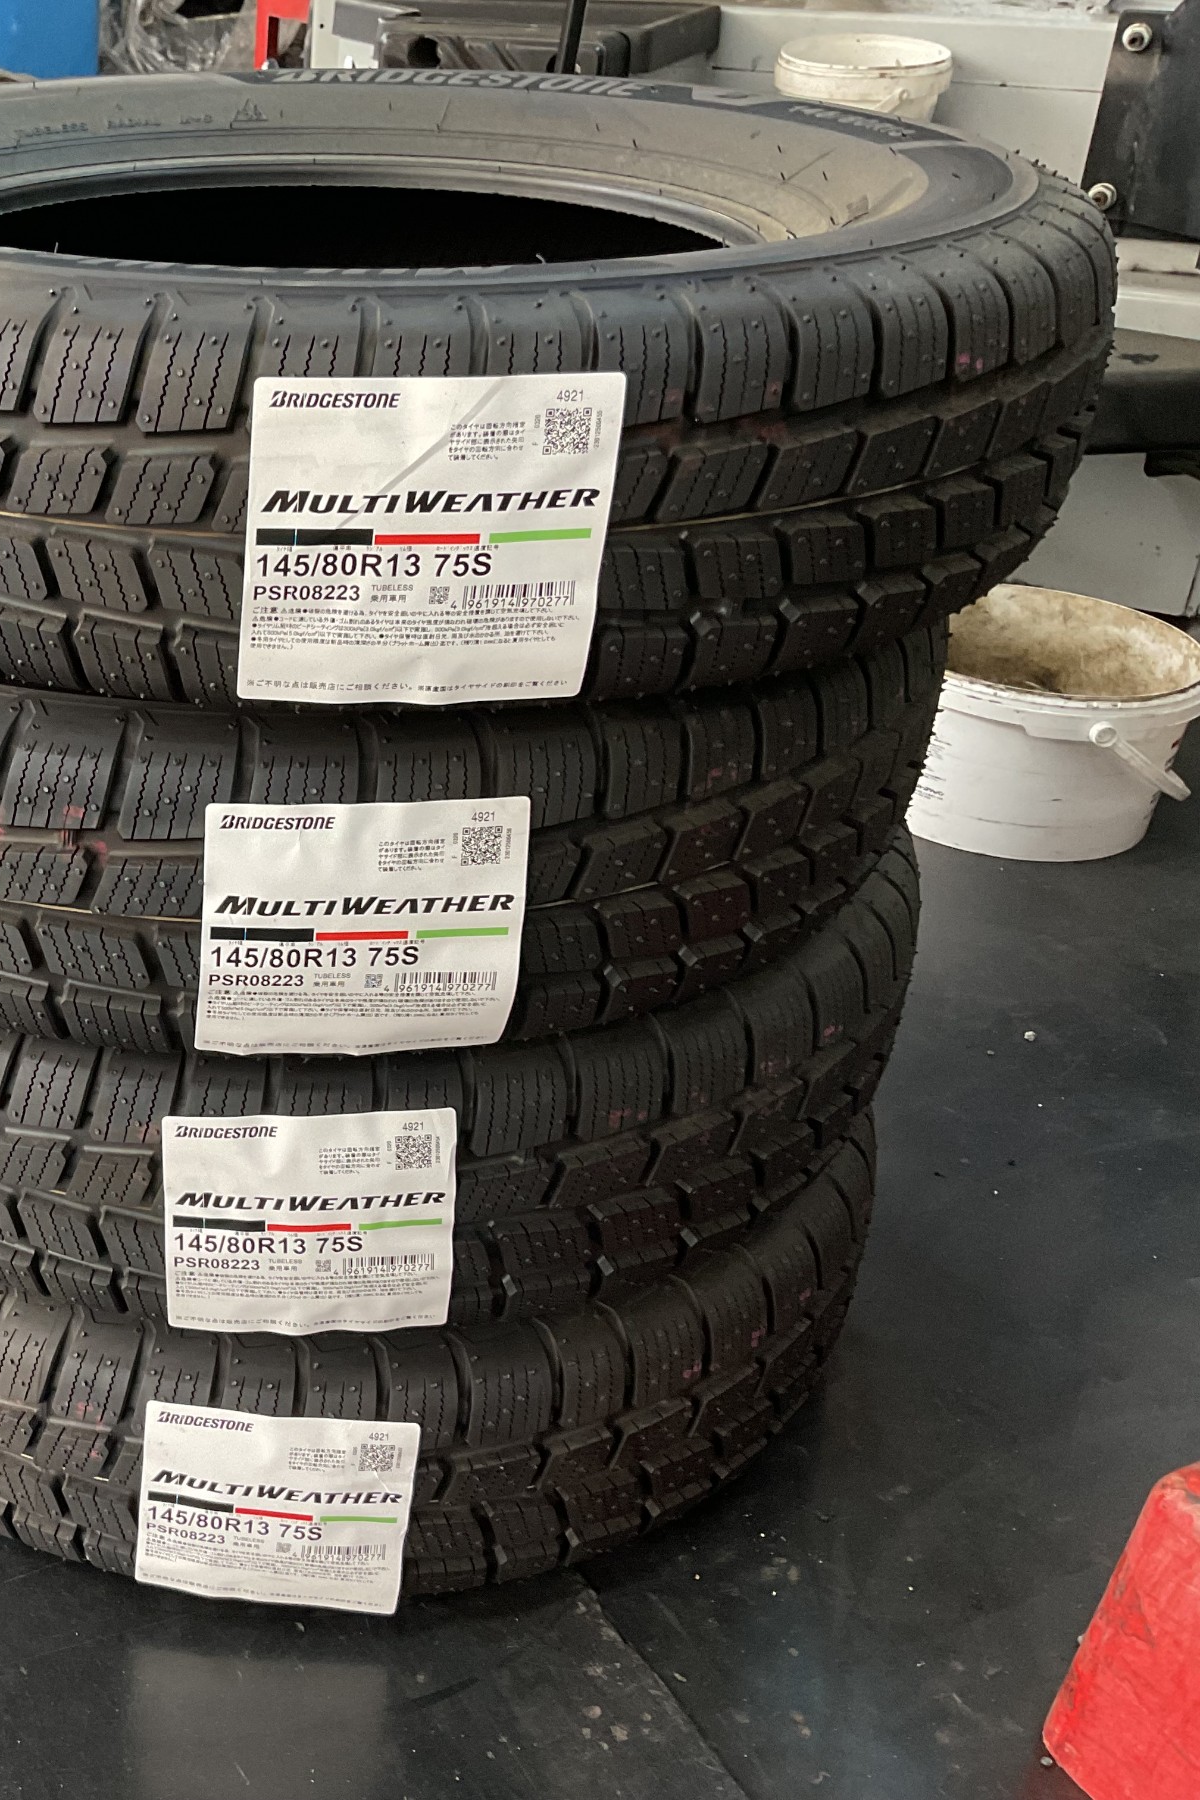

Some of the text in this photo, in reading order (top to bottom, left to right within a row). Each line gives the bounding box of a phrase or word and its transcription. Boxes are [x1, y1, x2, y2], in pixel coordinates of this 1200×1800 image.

[272, 68, 646, 98] BRIDGESTONE
[269, 390, 400, 408] BRIDGESTONE
[557, 389, 584, 402] 4921
[256, 552, 493, 577] 145/80R13 75S
[253, 585, 360, 601] PSR08223
[371, 584, 413, 592] TUBELESS
[219, 815, 335, 830] BRIDGESTONE
[471, 811, 495, 822] 4921
[210, 946, 419, 968] 145/80R13 75S
[208, 974, 304, 986] PSR08223
[174, 1125, 278, 1139] BRIDGESTONE
[402, 1122, 425, 1131] 4921
[174, 1235, 363, 1255] 145/80R13 75S
[174, 1257, 260, 1270] PSR08223
[157, 1411, 254, 1432] BRIDGESTONE
[369, 1432, 389, 1441] 4921
[147, 1506, 322, 1541] 145/80R13 75S
[146, 1522, 225, 1544] PSR08223
